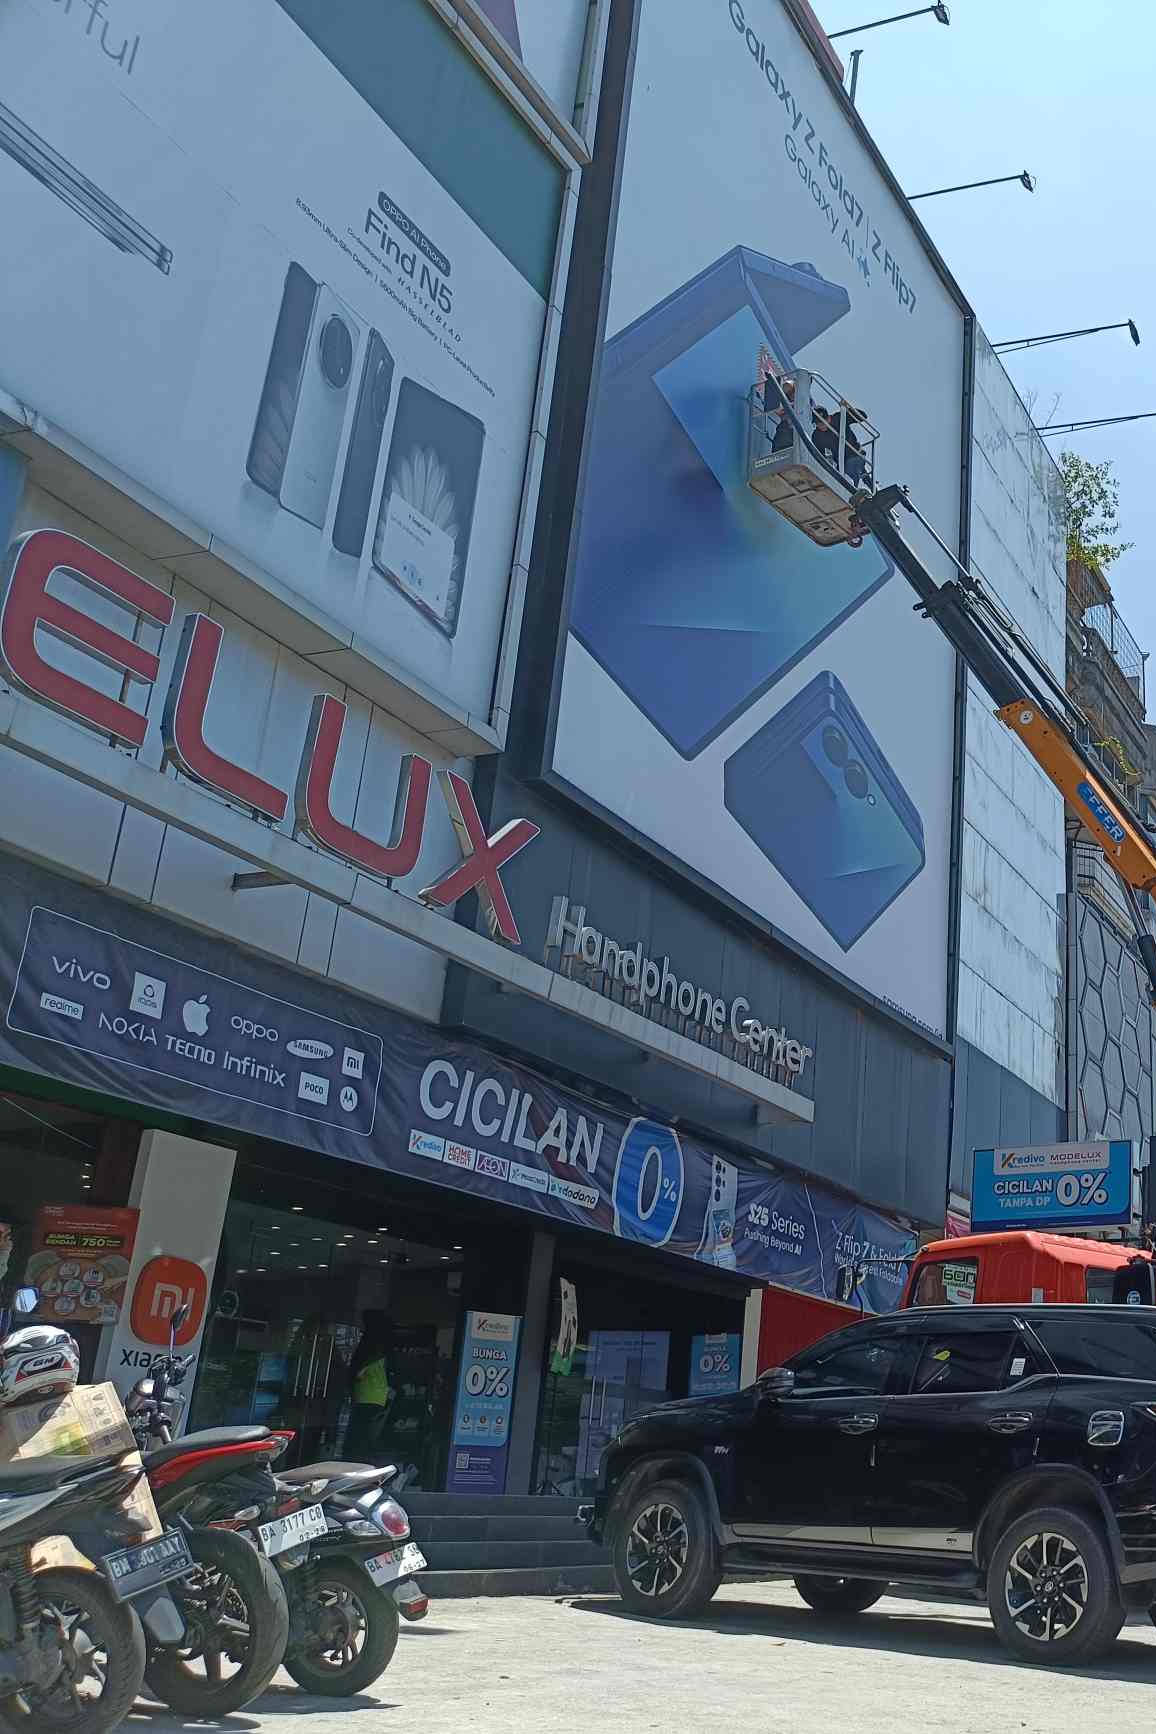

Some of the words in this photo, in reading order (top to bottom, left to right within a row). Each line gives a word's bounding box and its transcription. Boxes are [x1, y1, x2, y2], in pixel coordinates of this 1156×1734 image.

[729, 0, 803, 131] Galaxy
[803, 119, 816, 154] Z
[818, 142, 863, 227] Fold7
[871, 229, 881, 263] Z
[883, 249, 916, 313] Flip7
[785, 133, 838, 234] Galaxy
[841, 228, 854, 258] AI
[365, 207, 416, 279] Find
[420, 263, 453, 314] N5
[1, 528, 541, 945] ELUX
[546, 896, 726, 1034] Handphone
[731, 997, 813, 1075] Center
[52, 955, 111, 990] vivo
[294, 1041, 328, 1058] SAMSUNG
[44, 997, 80, 1016] realme
[98, 1012, 157, 1046] NOKIA
[165, 1034, 216, 1066] TECNO
[223, 1050, 287, 1088] Infinix
[304, 1081, 324, 1095] POCO
[419, 1059, 605, 1174] CICILAN
[1001, 1151, 1045, 1168] Kredivo
[1050, 1151, 1102, 1161] MODELUX
[994, 1178, 1052, 1195] CICILAN
[1056, 1172, 1108, 1208] 0%
[999, 1197, 1033, 1209] TANPA
[1035, 1196, 1051, 1208] DP
[748, 1203, 769, 1226] S25
[771, 1210, 806, 1241] Series
[81, 1237, 106, 1247] 750
[836, 1231, 843, 1250] Z
[843, 1234, 861, 1262] Flip
[472, 1346, 507, 1361] BUNGA
[700, 1354, 730, 1374] 0%
[464, 1364, 510, 1397] 0%
[260, 1524, 277, 1541] BA
[280, 1511, 307, 1533] 3177
[366, 1556, 383, 1573] BA
